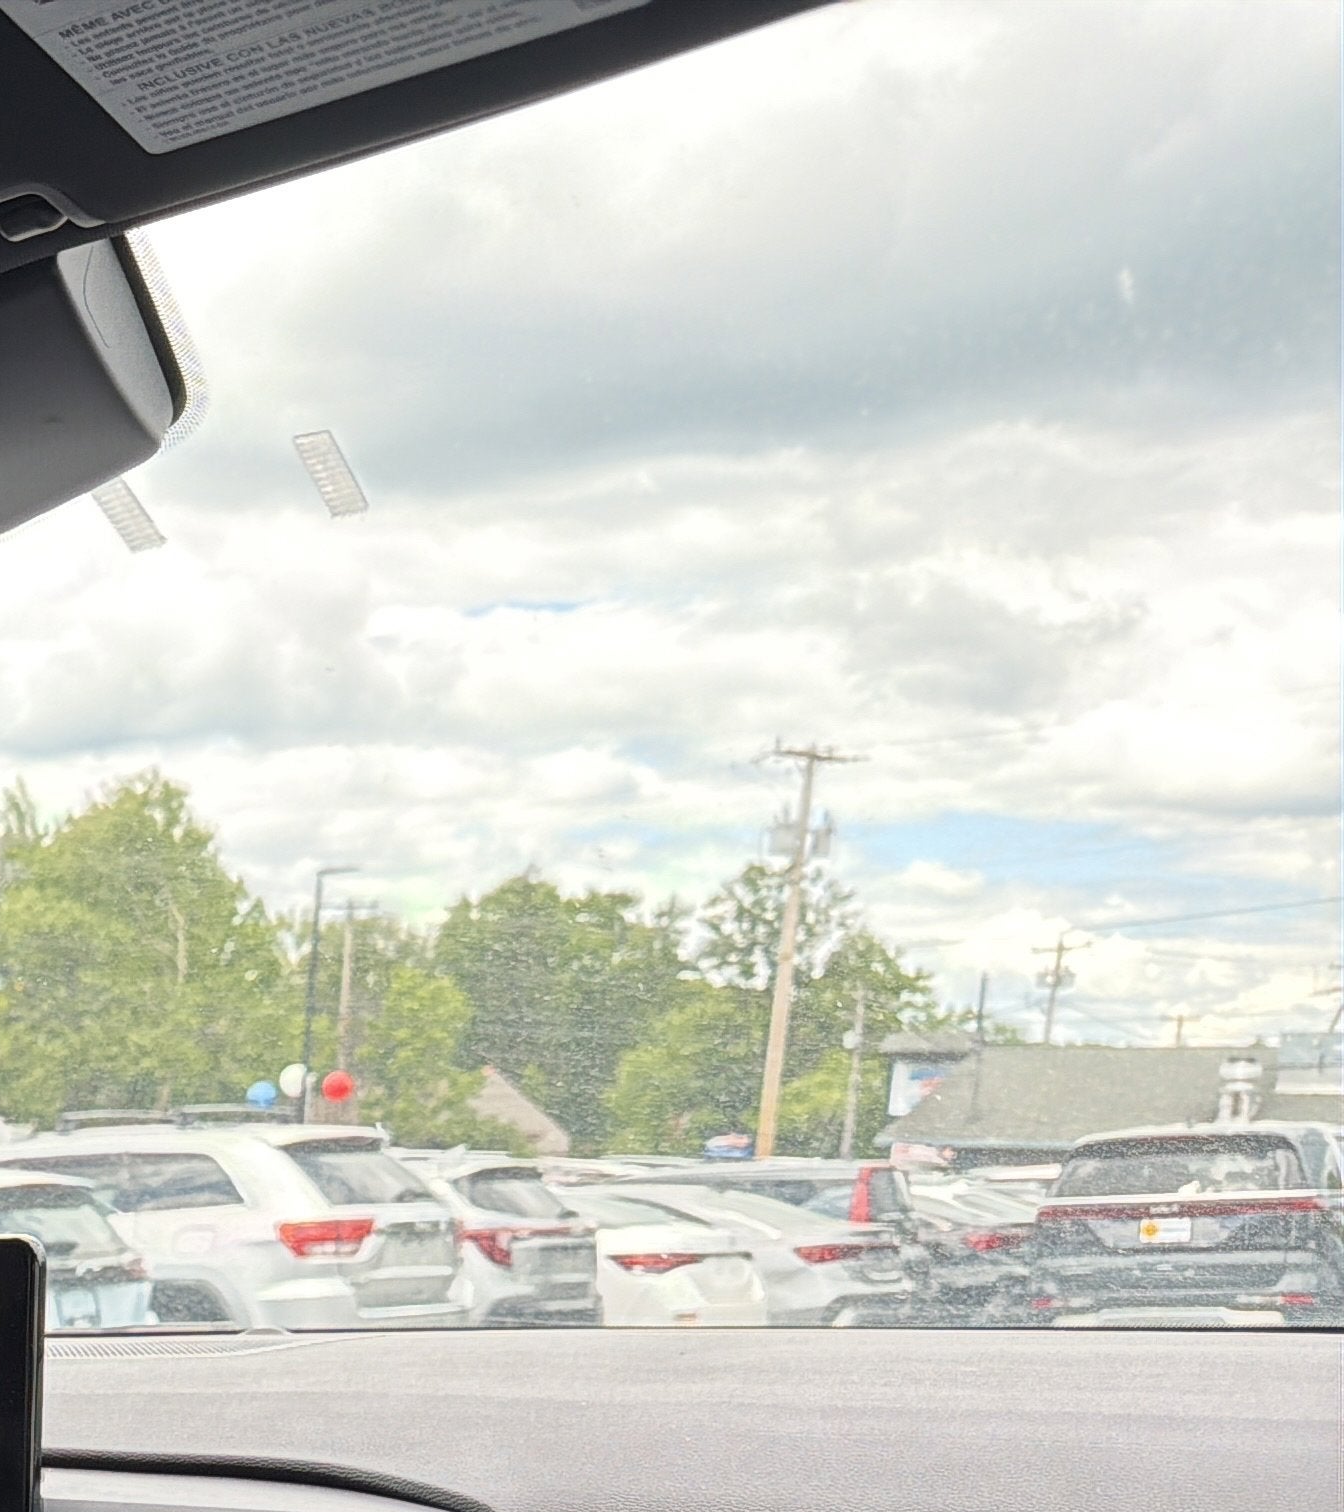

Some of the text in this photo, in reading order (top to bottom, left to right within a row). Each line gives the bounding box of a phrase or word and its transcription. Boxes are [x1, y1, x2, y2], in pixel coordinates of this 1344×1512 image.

[59, 1, 156, 38] MÊME AVEC
[139, 58, 223, 90] INCLUSIVE
[227, 45, 264, 61] CON
[267, 33, 300, 47] LAS
[304, 9, 377, 35] NUEVAS
